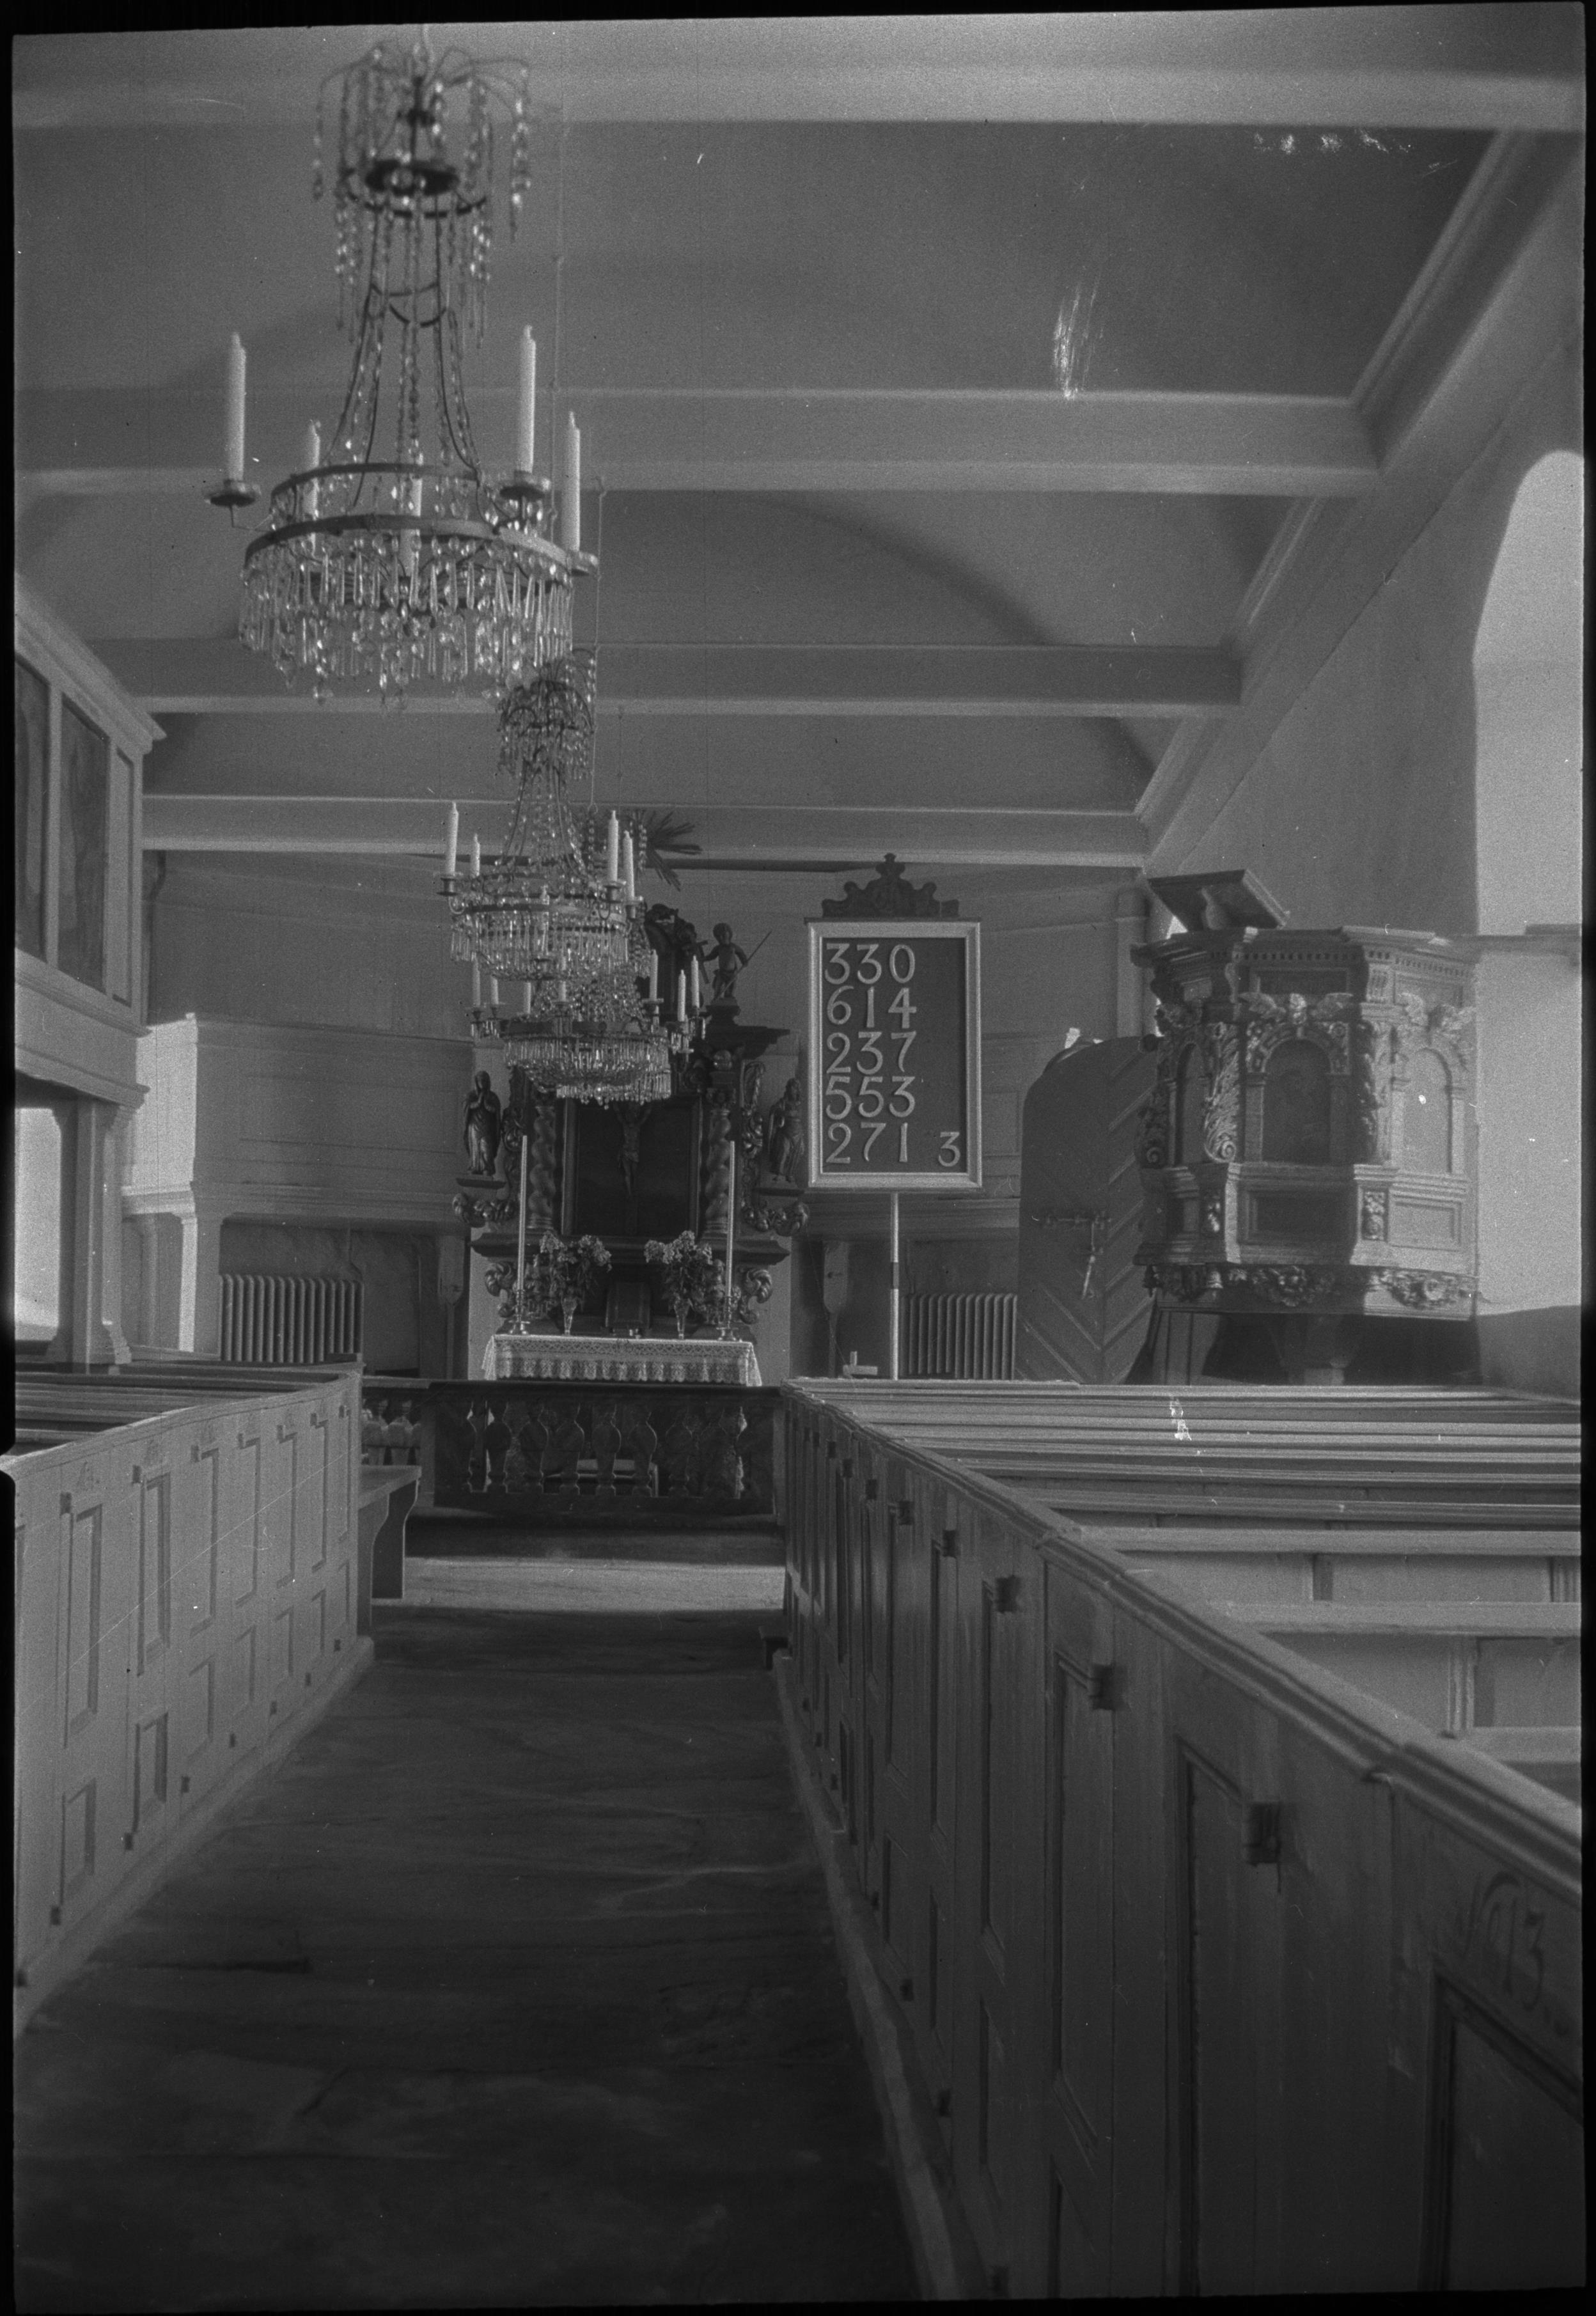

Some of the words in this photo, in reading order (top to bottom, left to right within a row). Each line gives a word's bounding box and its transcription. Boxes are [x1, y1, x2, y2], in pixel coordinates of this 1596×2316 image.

[825, 943, 916, 984] 330
[827, 985, 917, 1028] 614
[826, 1031, 917, 1074] 237
[825, 1076, 916, 1120] 553
[826, 1122, 908, 1164] 271
[938, 1132, 960, 1168] 3
